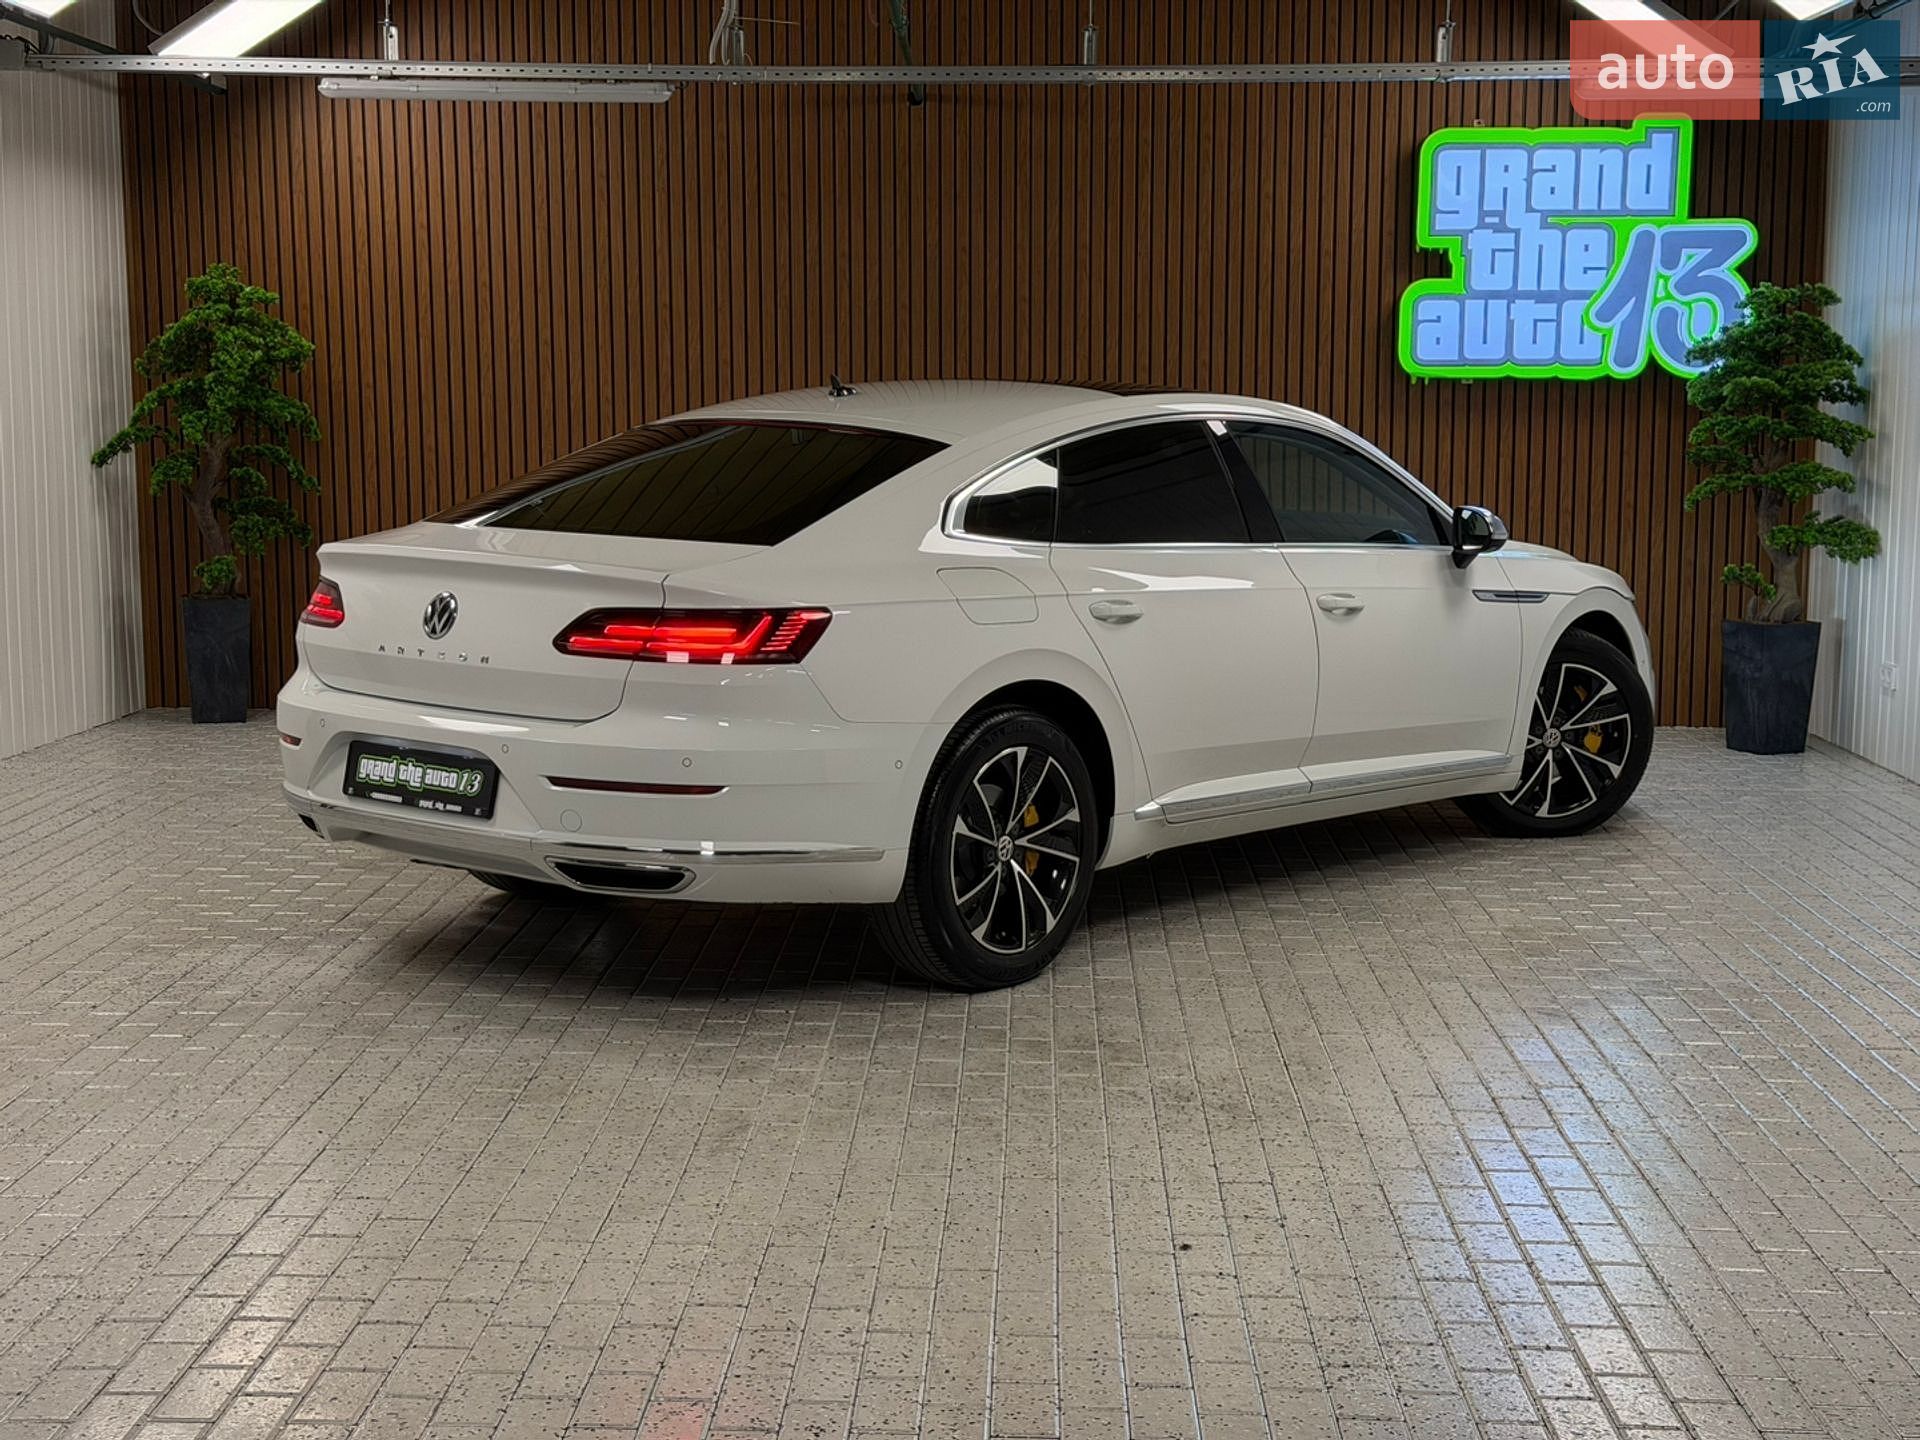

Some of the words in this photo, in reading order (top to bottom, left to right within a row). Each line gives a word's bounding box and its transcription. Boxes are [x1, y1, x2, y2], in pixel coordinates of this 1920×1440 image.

[1468, 210, 1609, 291] the
[1590, 224, 1752, 373] 13
[1416, 299, 1604, 361] auto
[459, 772, 483, 794] 13
